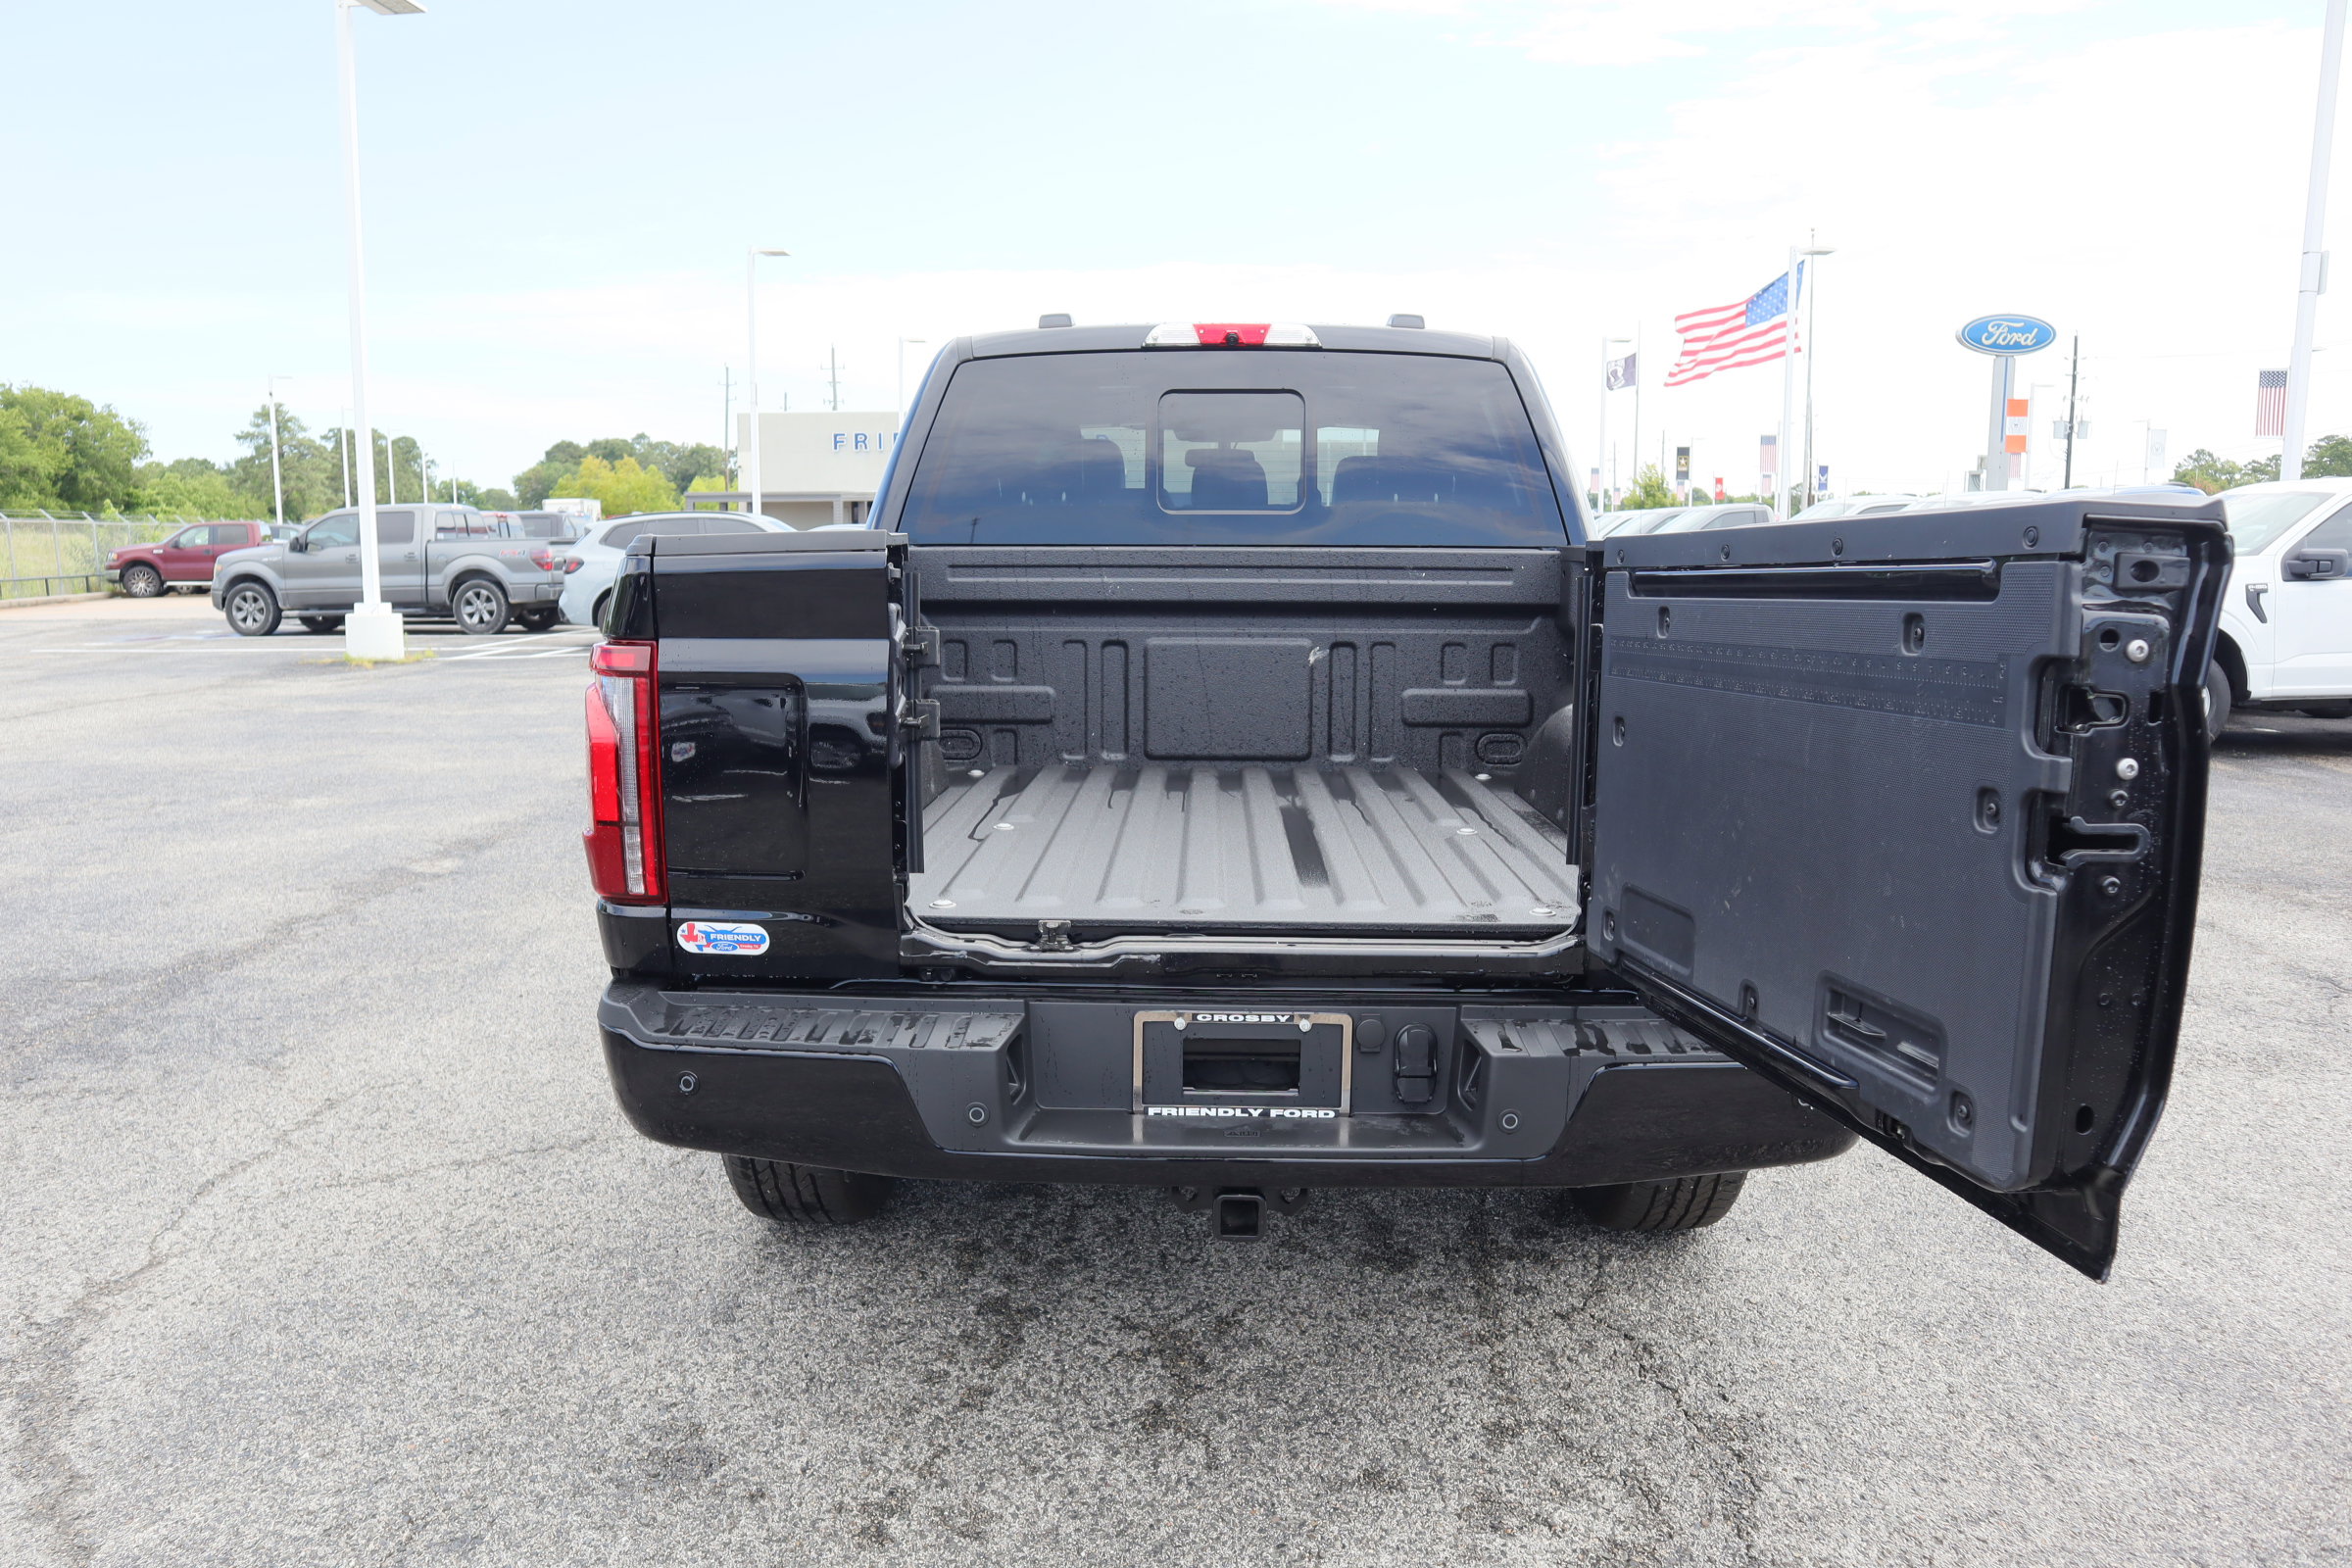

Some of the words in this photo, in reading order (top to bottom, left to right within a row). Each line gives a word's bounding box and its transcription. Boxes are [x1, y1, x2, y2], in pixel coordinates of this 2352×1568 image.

[1981, 320, 2039, 346] Ford
[710, 933, 761, 942] FRIENDLY
[1196, 1013, 1291, 1023] CROSBY
[1148, 1106, 1263, 1117] FRIENDLY
[1269, 1108, 1336, 1119] FORD
